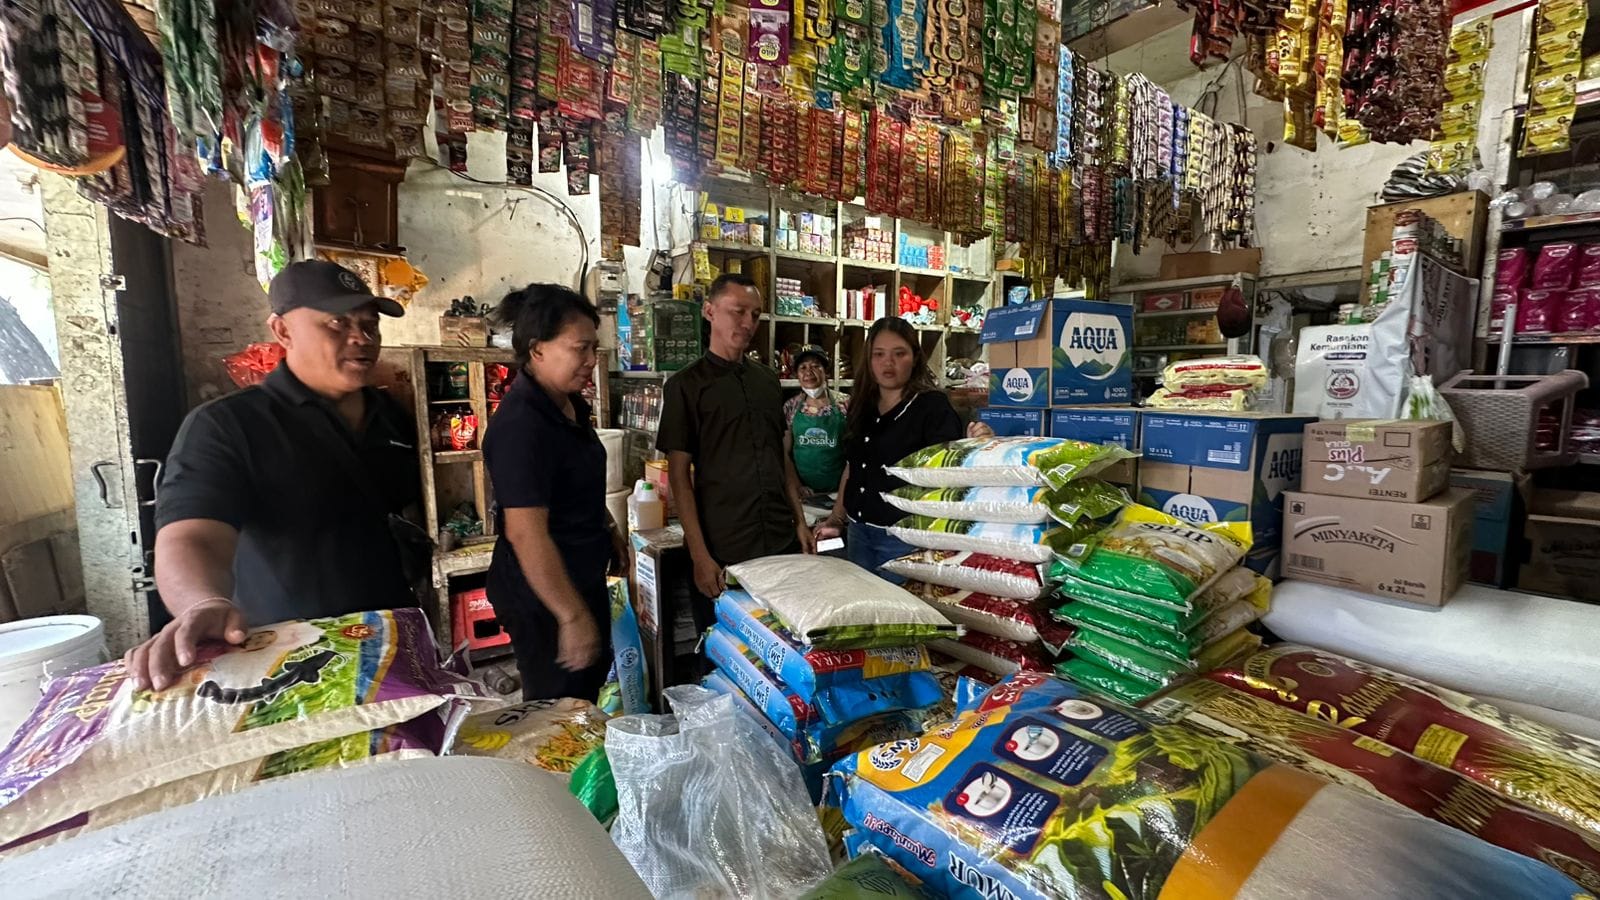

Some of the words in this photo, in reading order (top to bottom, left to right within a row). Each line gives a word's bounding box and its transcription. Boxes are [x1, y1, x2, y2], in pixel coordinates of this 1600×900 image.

[1069, 326, 1118, 353] AQUA
[1006, 377, 1029, 390] AQUA
[1268, 448, 1303, 481] AQU
[1328, 445, 1365, 464] Plus
[1322, 464, 1391, 485] AC
[1169, 504, 1210, 522] AQUA
[1310, 528, 1395, 553] MINYAKITA
[1378, 583, 1385, 591] 6
[1395, 586, 1407, 595] 2L
[812, 651, 852, 667] CARA
[880, 740, 908, 763] SM
